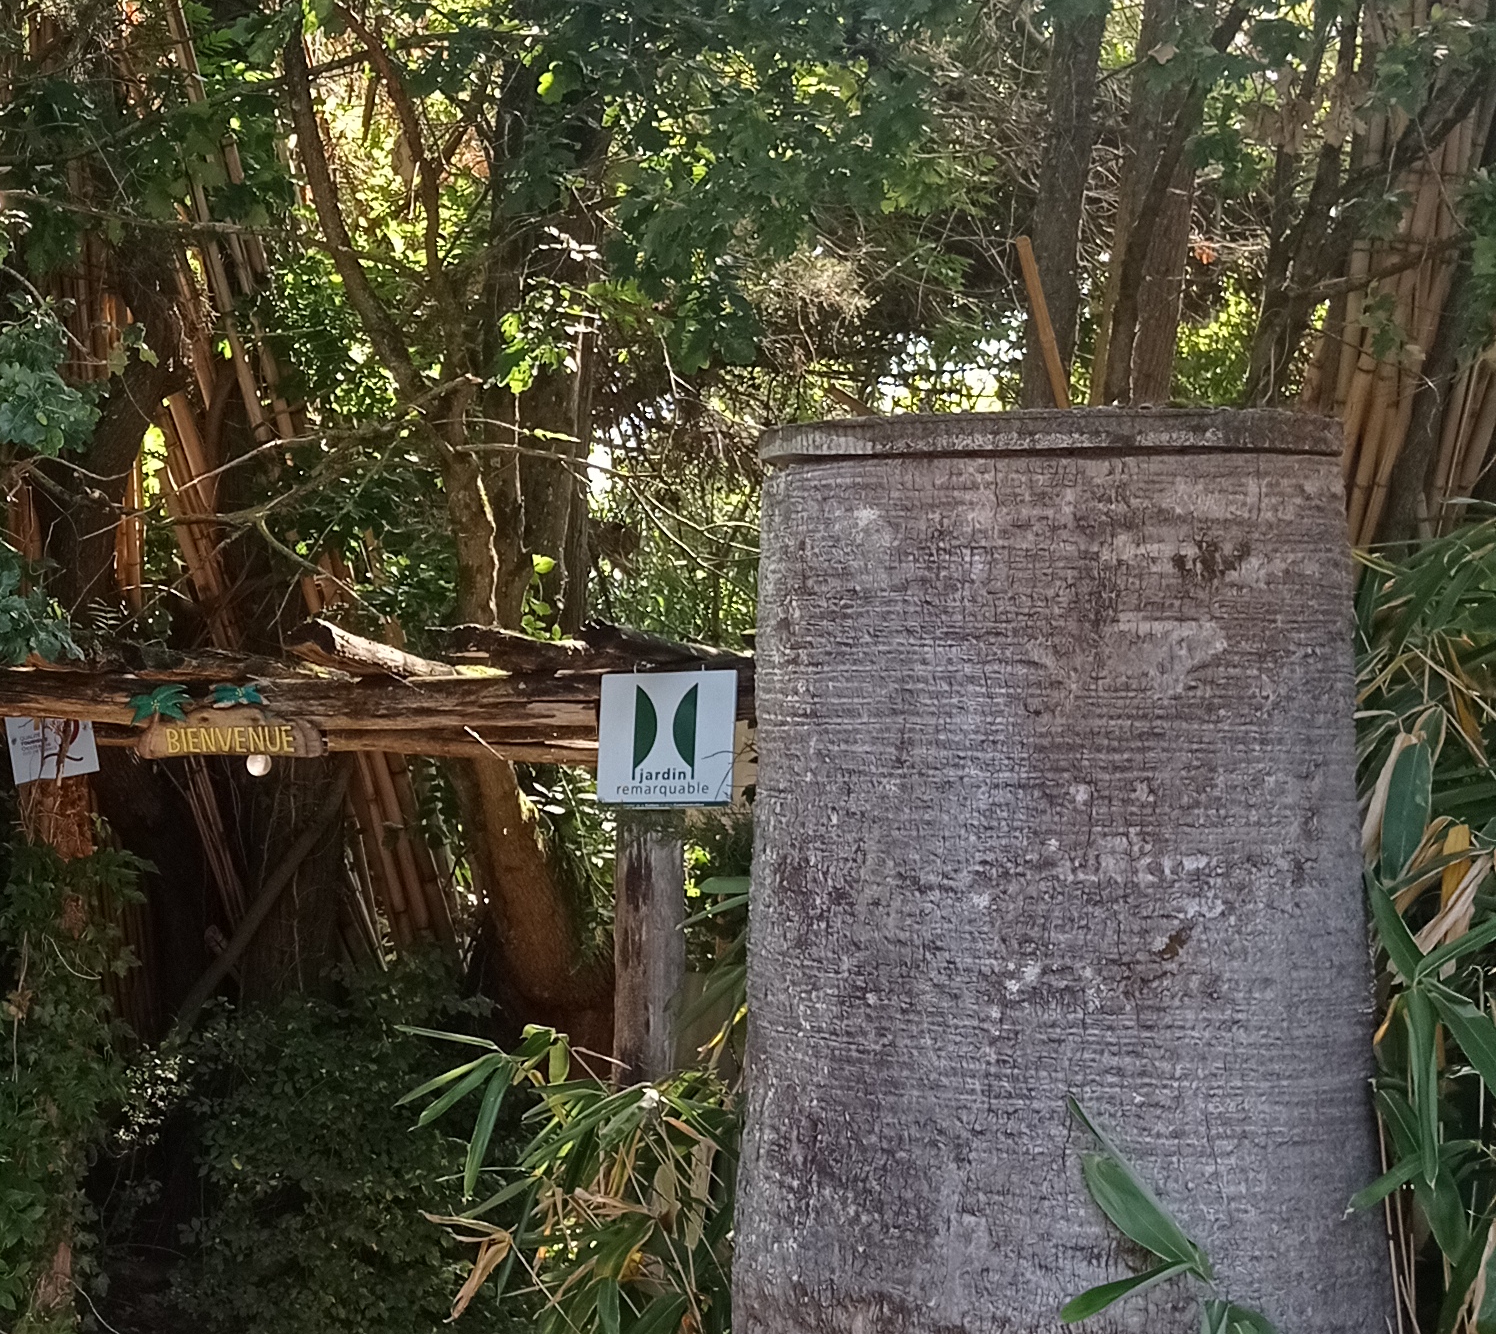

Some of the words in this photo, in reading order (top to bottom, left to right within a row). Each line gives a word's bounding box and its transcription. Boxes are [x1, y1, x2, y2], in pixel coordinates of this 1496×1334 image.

[165, 725, 296, 754] BIENVENUE
[638, 768, 687, 784] jardin
[616, 782, 710, 797] remarquable
